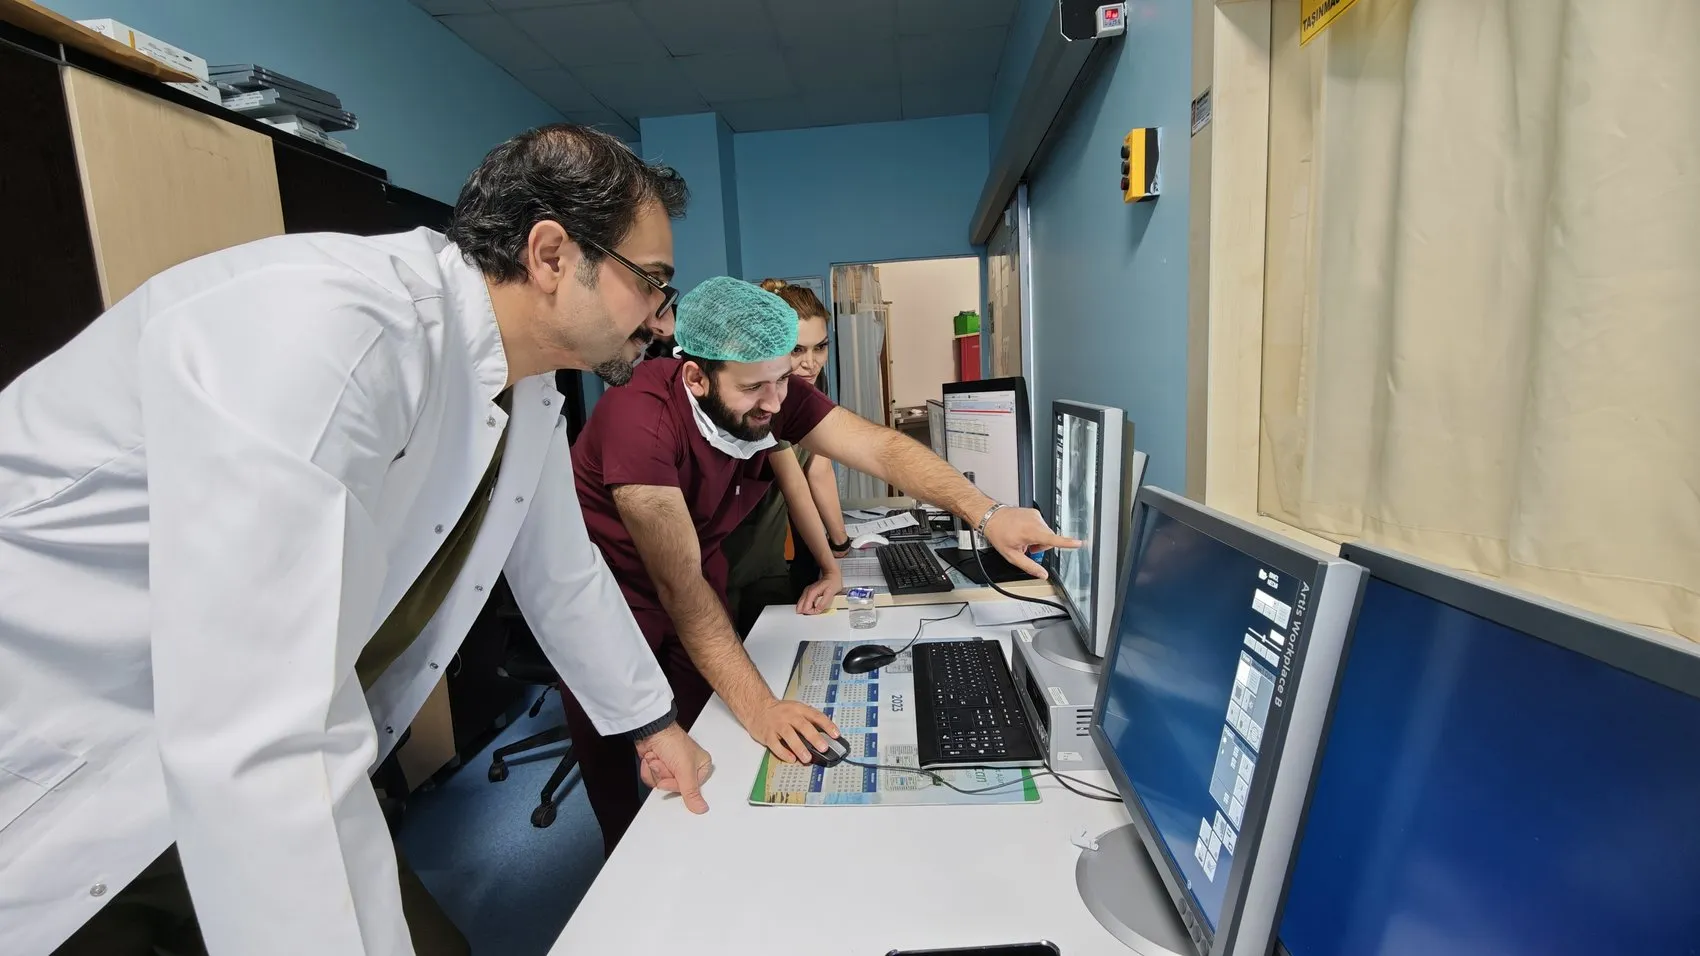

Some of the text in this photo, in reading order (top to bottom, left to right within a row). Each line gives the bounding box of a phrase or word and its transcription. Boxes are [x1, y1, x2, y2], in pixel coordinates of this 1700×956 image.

[1274, 581, 1310, 707] Artis Workplace B
[892, 694, 904, 712] 2023
